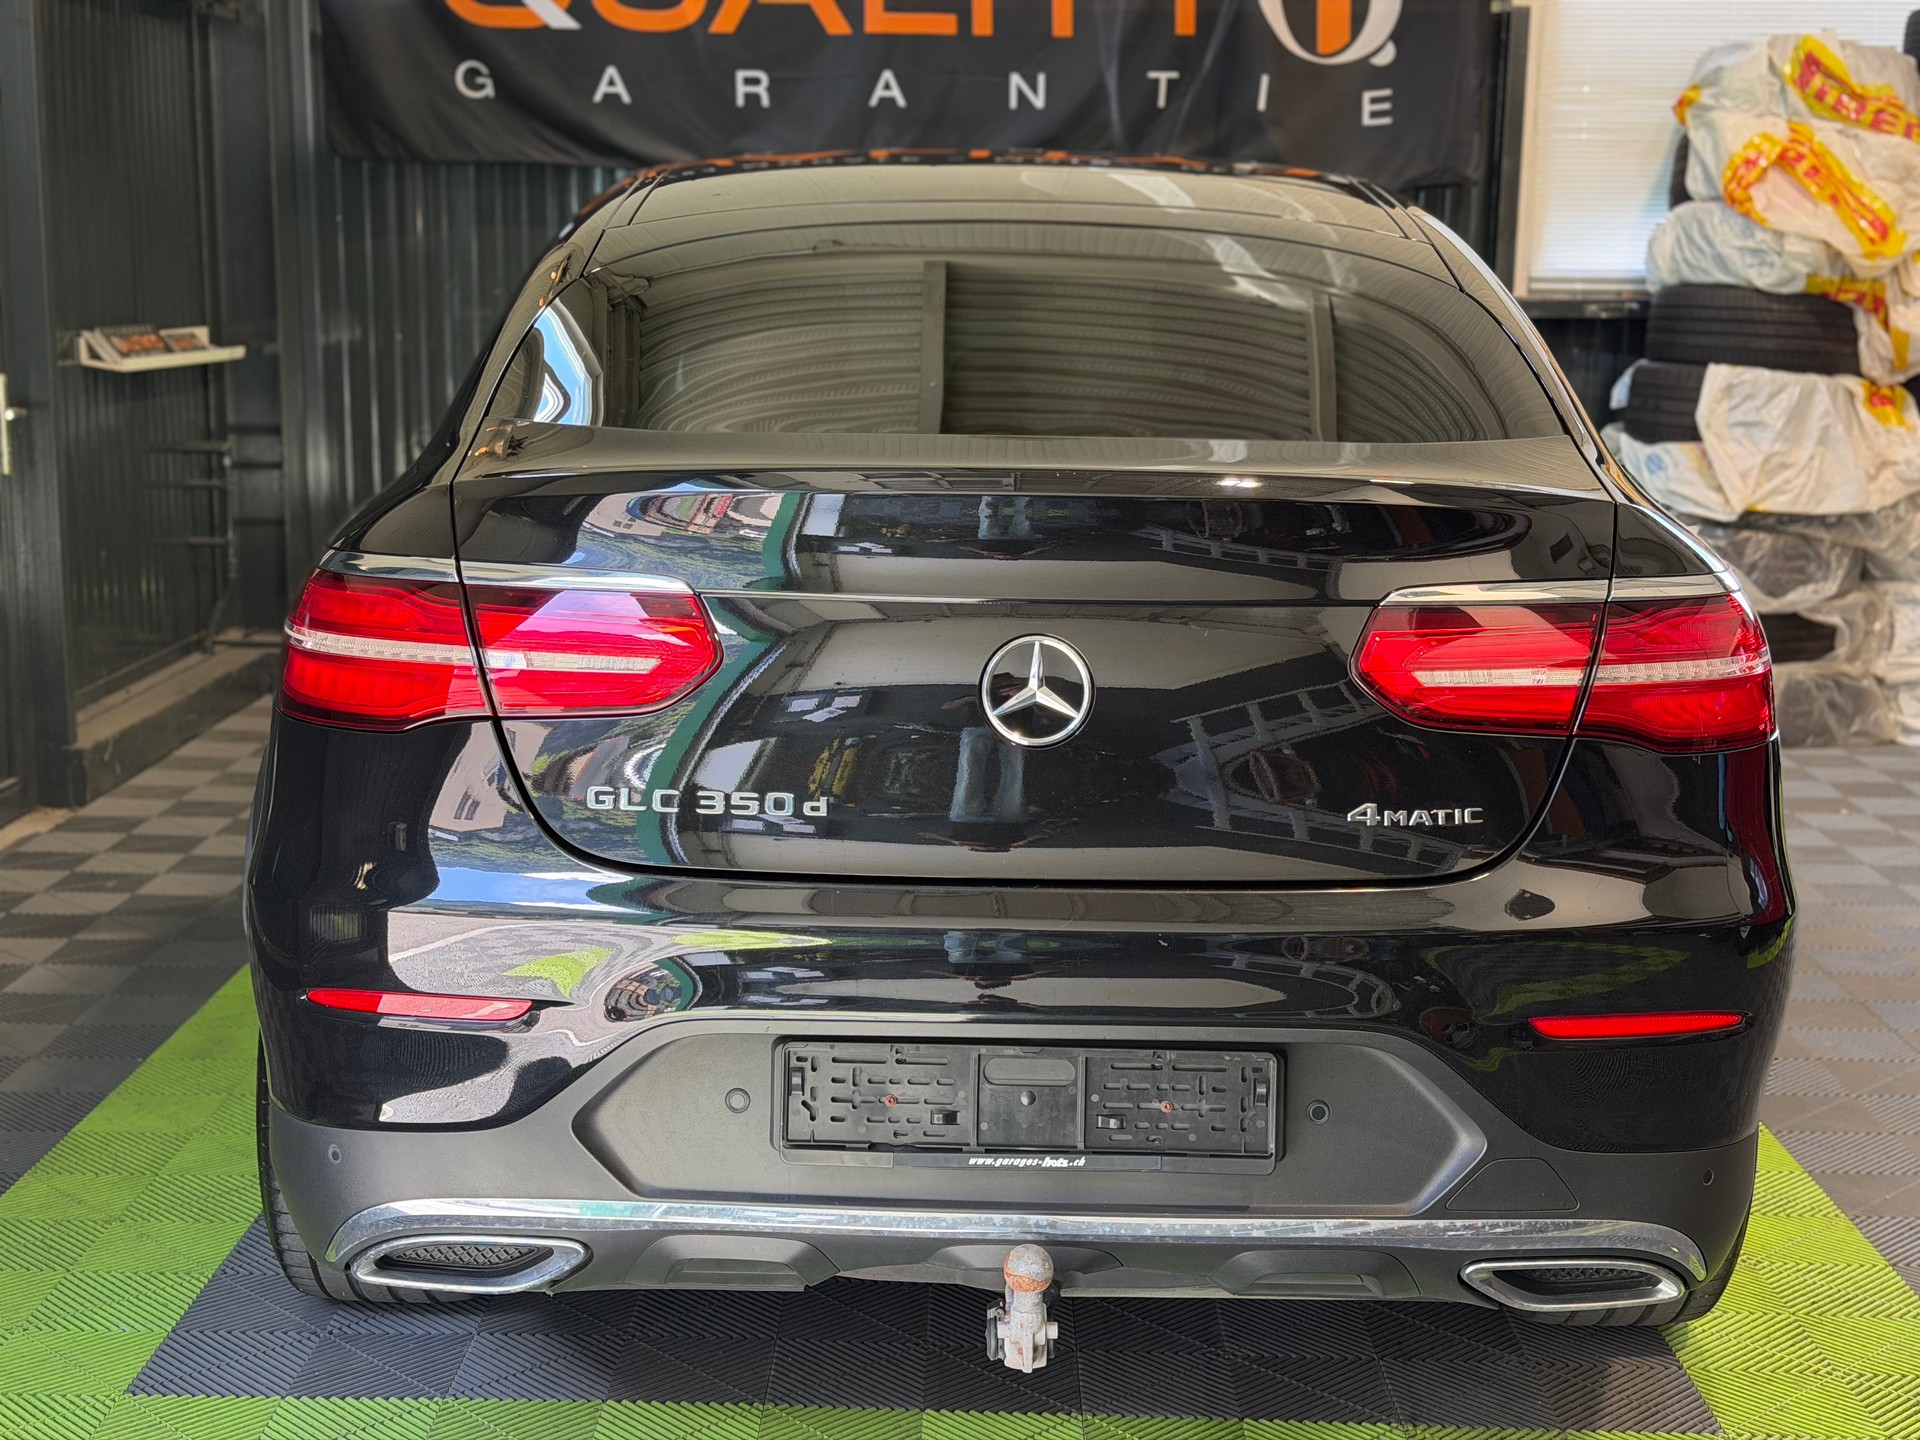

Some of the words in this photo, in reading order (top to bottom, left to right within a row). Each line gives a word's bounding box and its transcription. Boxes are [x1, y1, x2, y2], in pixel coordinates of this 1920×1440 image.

[454, 59, 1394, 127] GARANTIE
[586, 786, 681, 813] GLC
[695, 791, 796, 816] 350
[803, 796, 829, 817] d
[1346, 802, 1485, 827] 4MATIC
